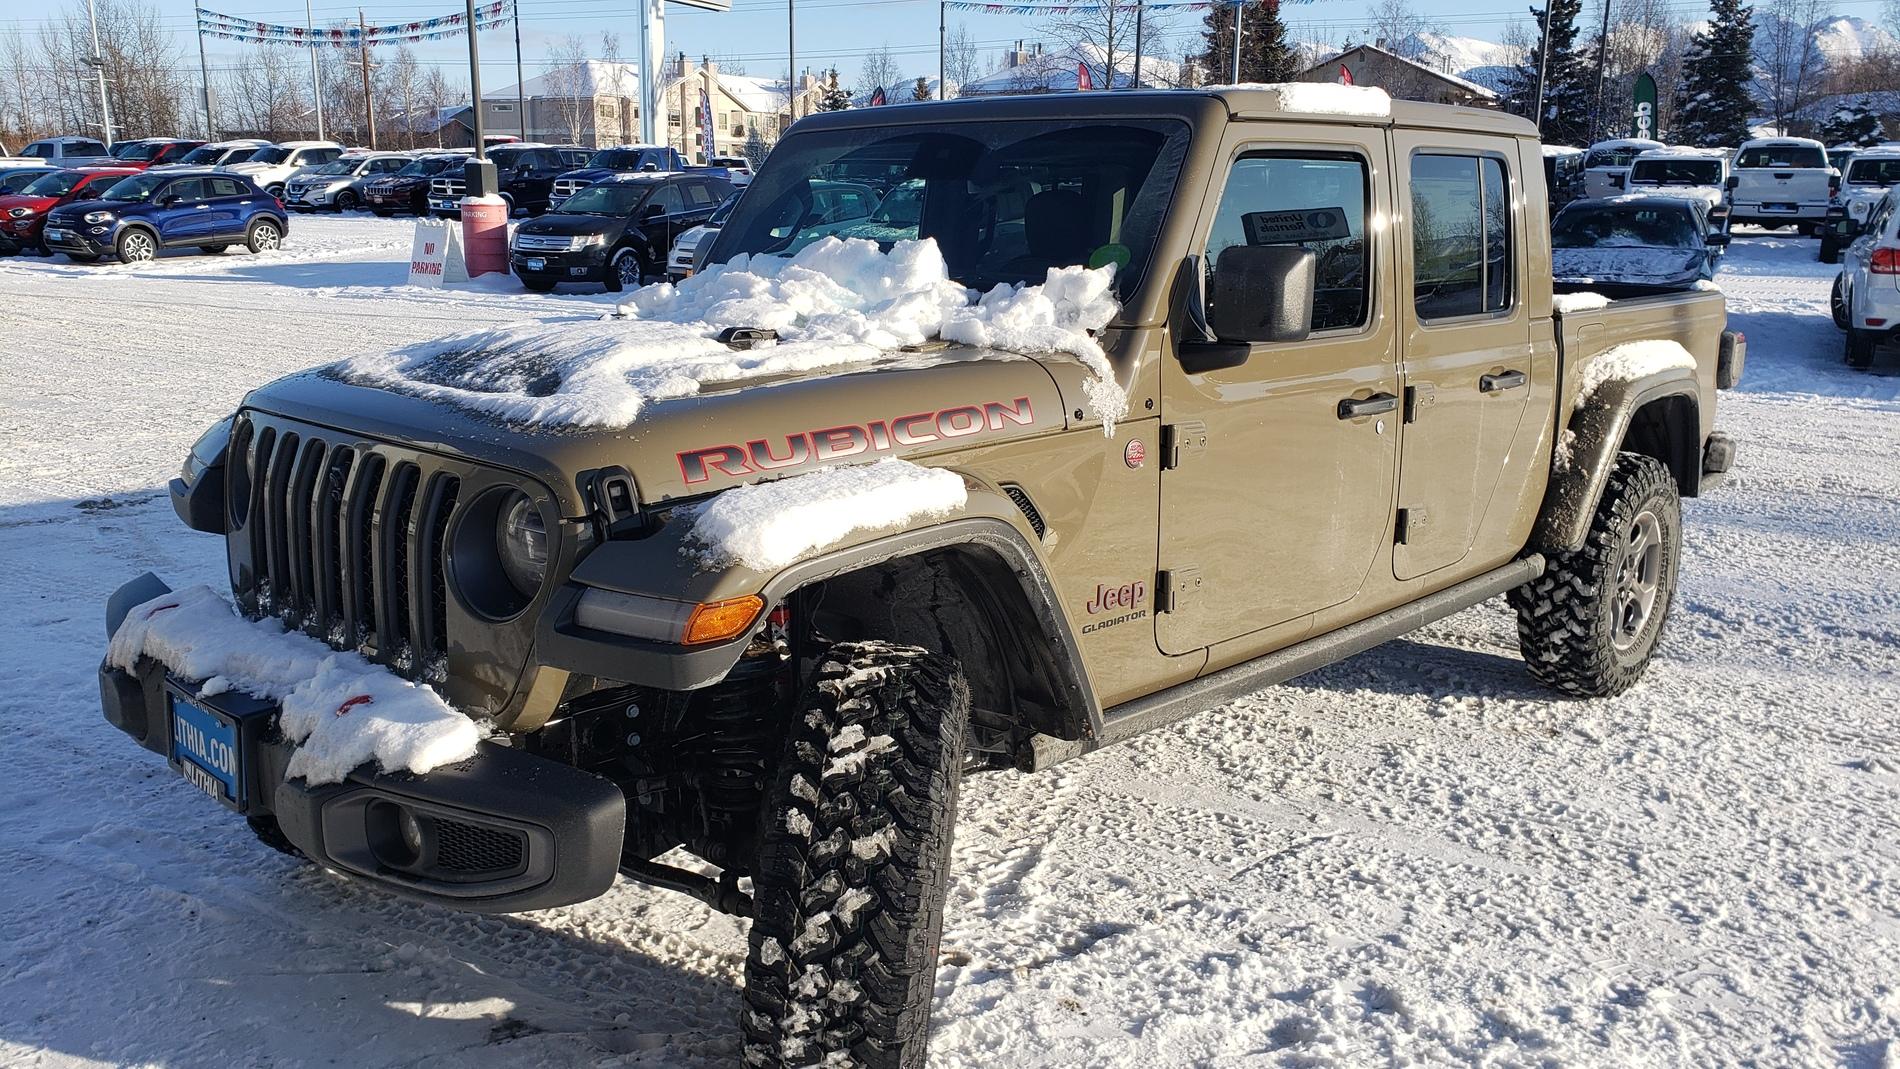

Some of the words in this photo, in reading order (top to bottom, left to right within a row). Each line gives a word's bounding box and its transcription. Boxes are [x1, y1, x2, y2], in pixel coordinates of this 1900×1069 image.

[1633, 102, 1652, 139] eep
[423, 242, 435, 256] NO
[411, 261, 442, 276] PARKING
[676, 397, 1034, 484] RUBICON
[1086, 580, 1147, 615] Jeep
[1082, 609, 1147, 634] GLADIATOR
[190, 764, 219, 801] LITHIA
